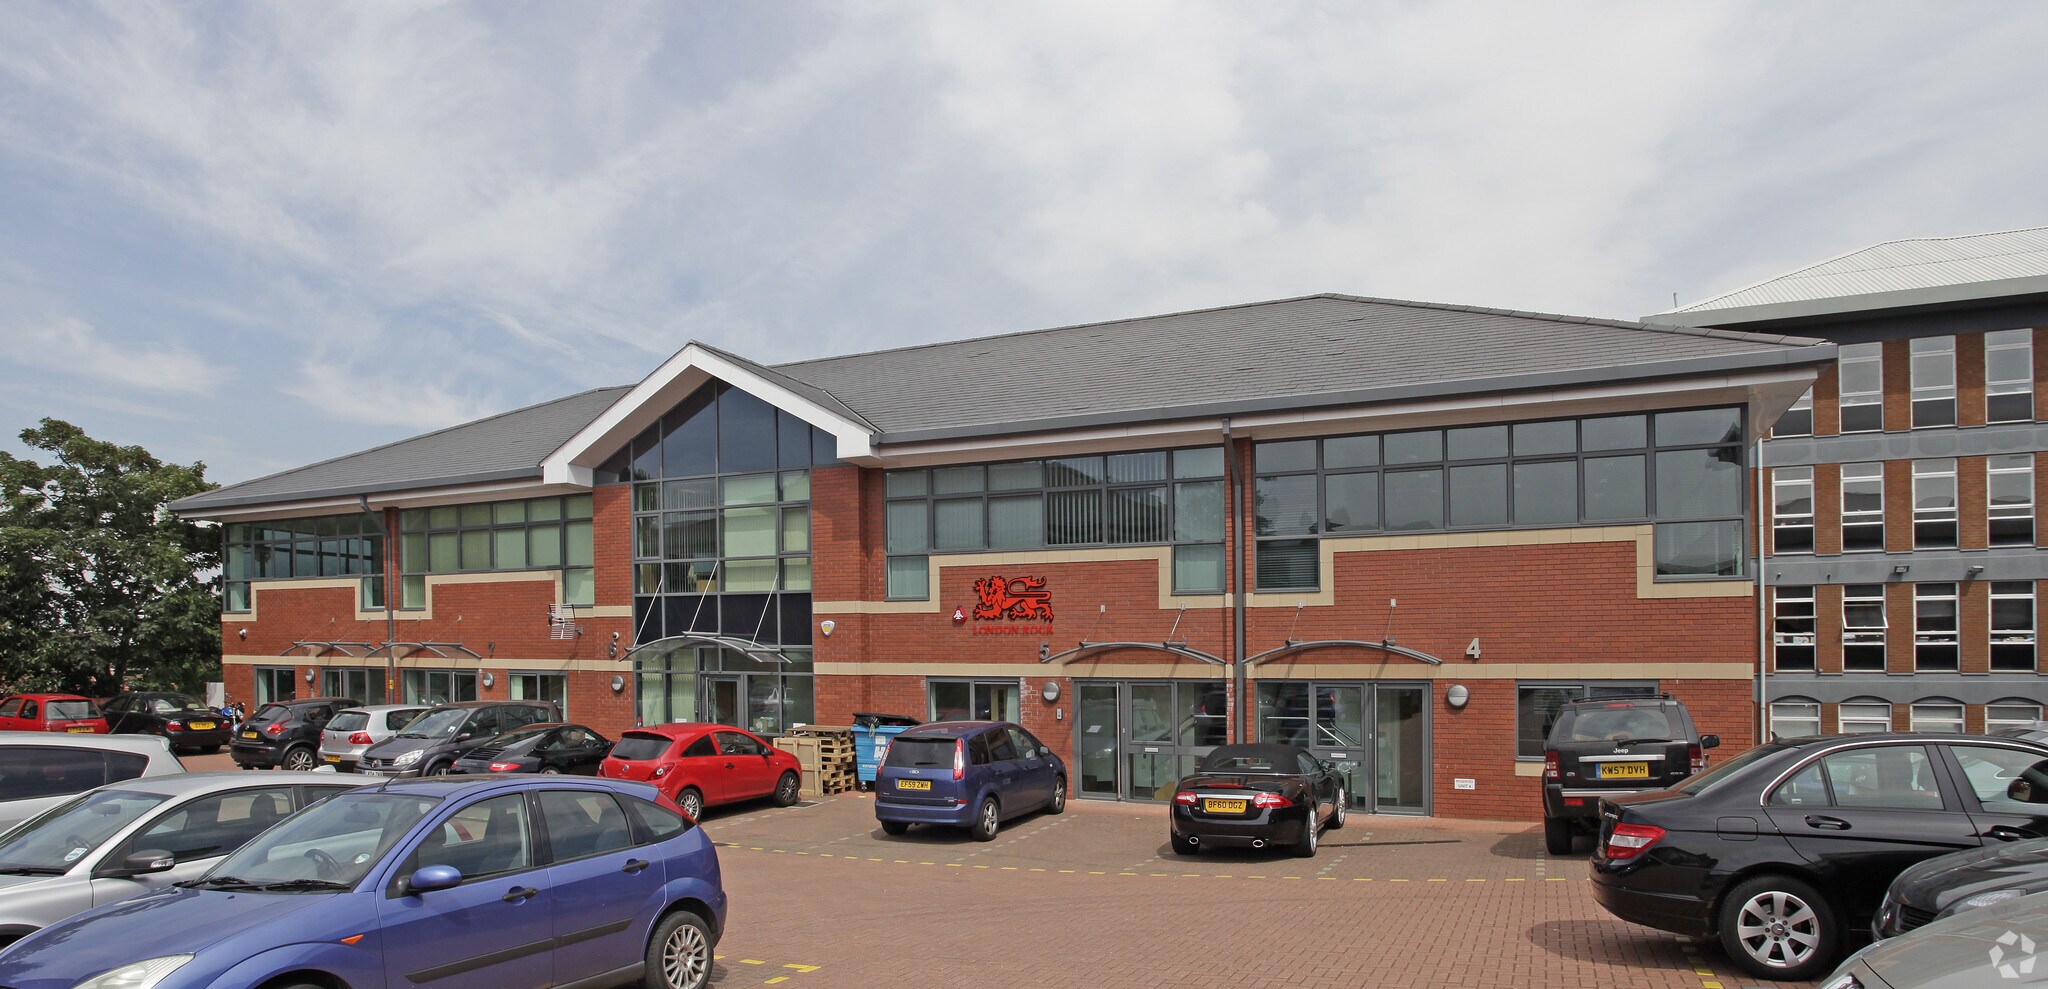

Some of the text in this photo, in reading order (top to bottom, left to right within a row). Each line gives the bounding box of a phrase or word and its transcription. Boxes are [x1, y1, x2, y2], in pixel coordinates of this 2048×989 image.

[972, 625, 1054, 636] LONDON ROCK
[488, 641, 496, 658] 7
[1039, 641, 1050, 660] 5
[1466, 637, 1481, 659] 4
[1601, 765, 1646, 775] KW57 DVH
[900, 780, 916, 788] EF59
[1208, 800, 1227, 809] BF60
